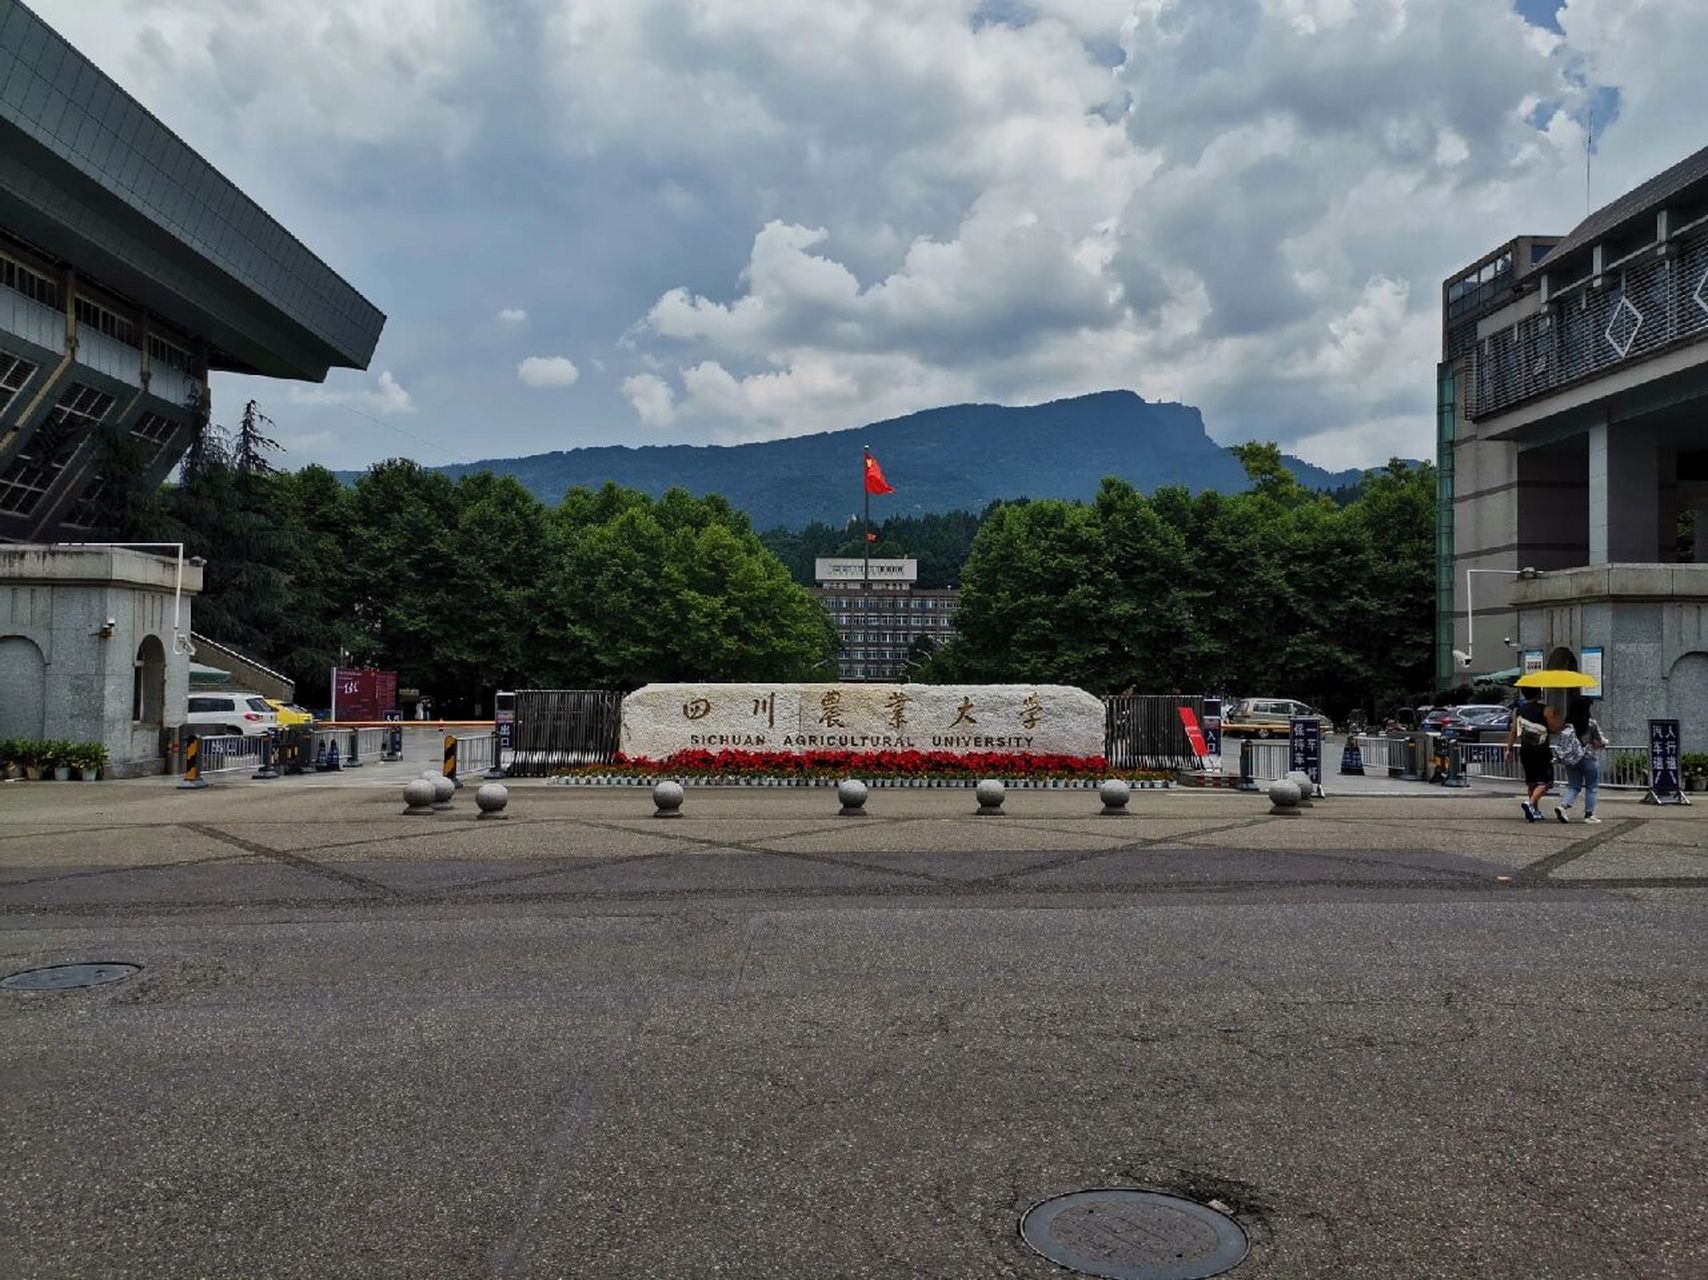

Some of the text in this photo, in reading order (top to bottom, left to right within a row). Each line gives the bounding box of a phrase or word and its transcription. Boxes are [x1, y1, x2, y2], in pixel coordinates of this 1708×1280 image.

[499, 724, 511, 746] 出口
[690, 734, 1035, 748] SICHUAN AGRICULTURAL UNIVERSITY
[1207, 730, 1216, 752] 入口
[1652, 724, 1664, 770] 汽车道
[1665, 725, 1677, 770] 人行道
